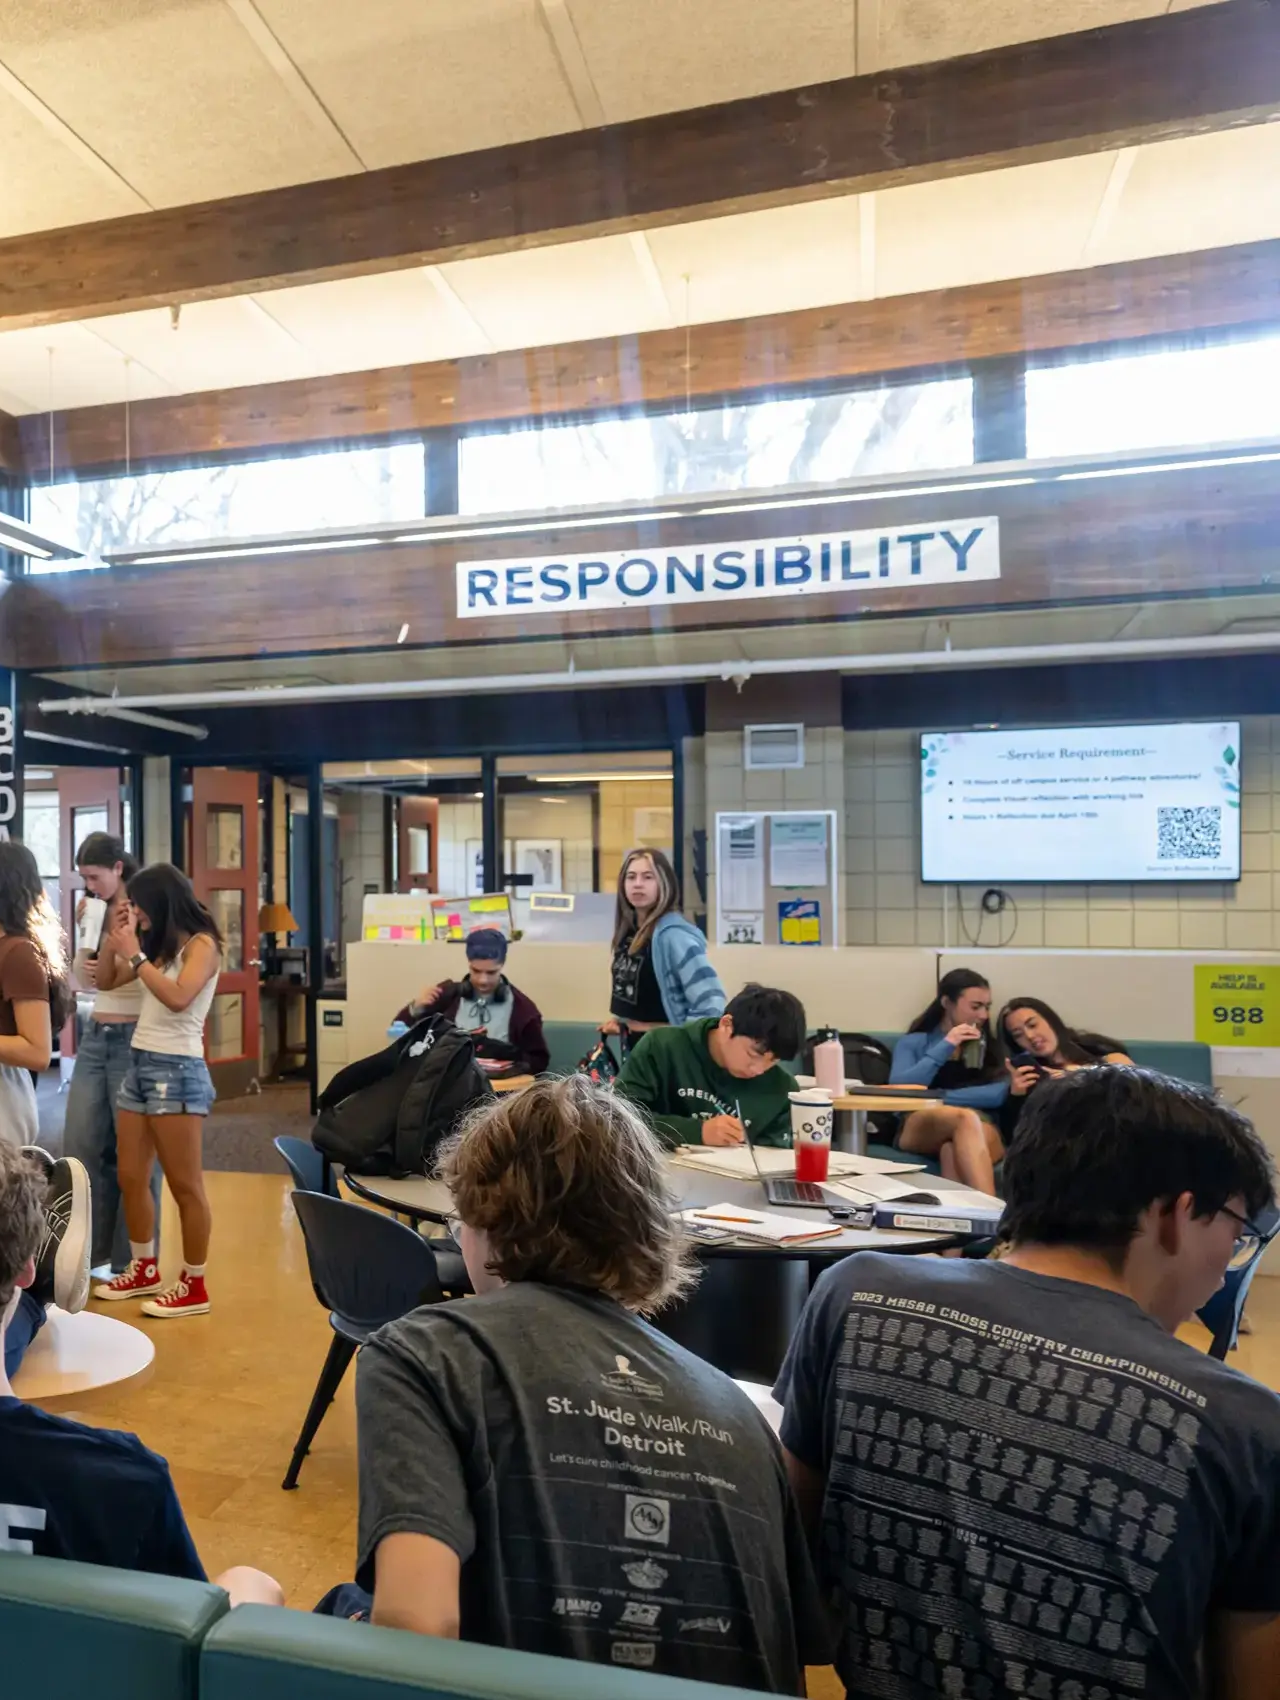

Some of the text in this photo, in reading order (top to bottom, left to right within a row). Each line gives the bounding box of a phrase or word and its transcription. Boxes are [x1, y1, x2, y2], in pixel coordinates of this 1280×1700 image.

[467, 527, 984, 609] RESPONSIBILITY
[1213, 1006, 1264, 1024] 988
[852, 1291, 884, 1304] 2023
[939, 1307, 989, 1330] CROSS
[992, 1323, 1068, 1353] COUNTRY
[1070, 1347, 1207, 1408] CHAMPIONSHIPS
[547, 1396, 734, 1446] St. Jude Walk/Run
[604, 1427, 686, 1457] Detroit
[575, 1456, 598, 1468] cure
[600, 1459, 653, 1476] childhood
